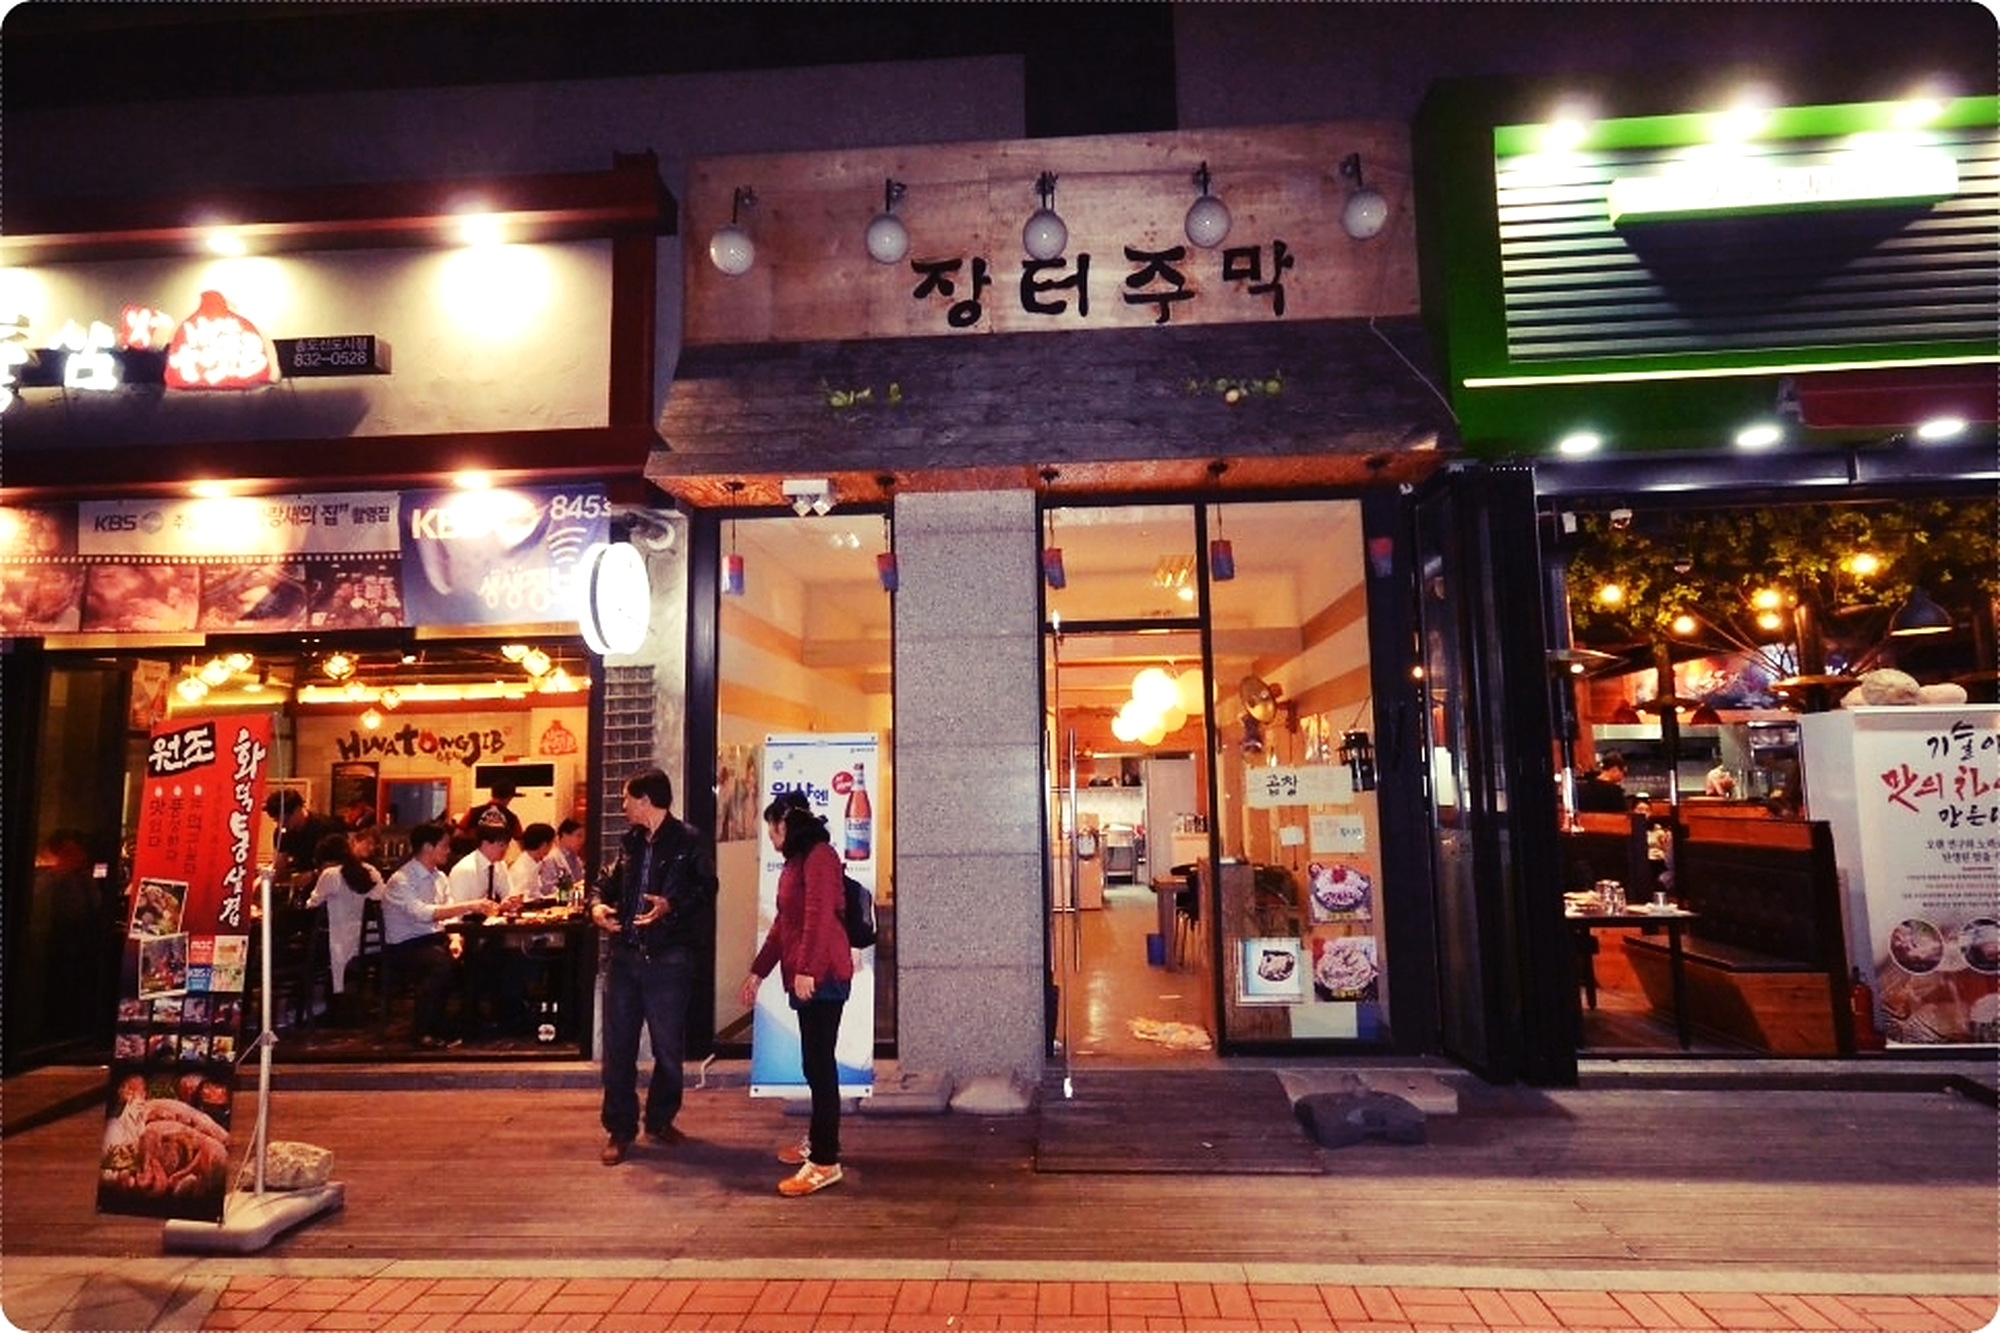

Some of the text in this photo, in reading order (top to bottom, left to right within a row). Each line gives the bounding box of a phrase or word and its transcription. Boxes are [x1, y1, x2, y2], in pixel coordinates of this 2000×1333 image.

[911, 240, 1294, 327] 장터주막
[94, 514, 137, 531] KBS
[148, 727, 215, 772] 원조
